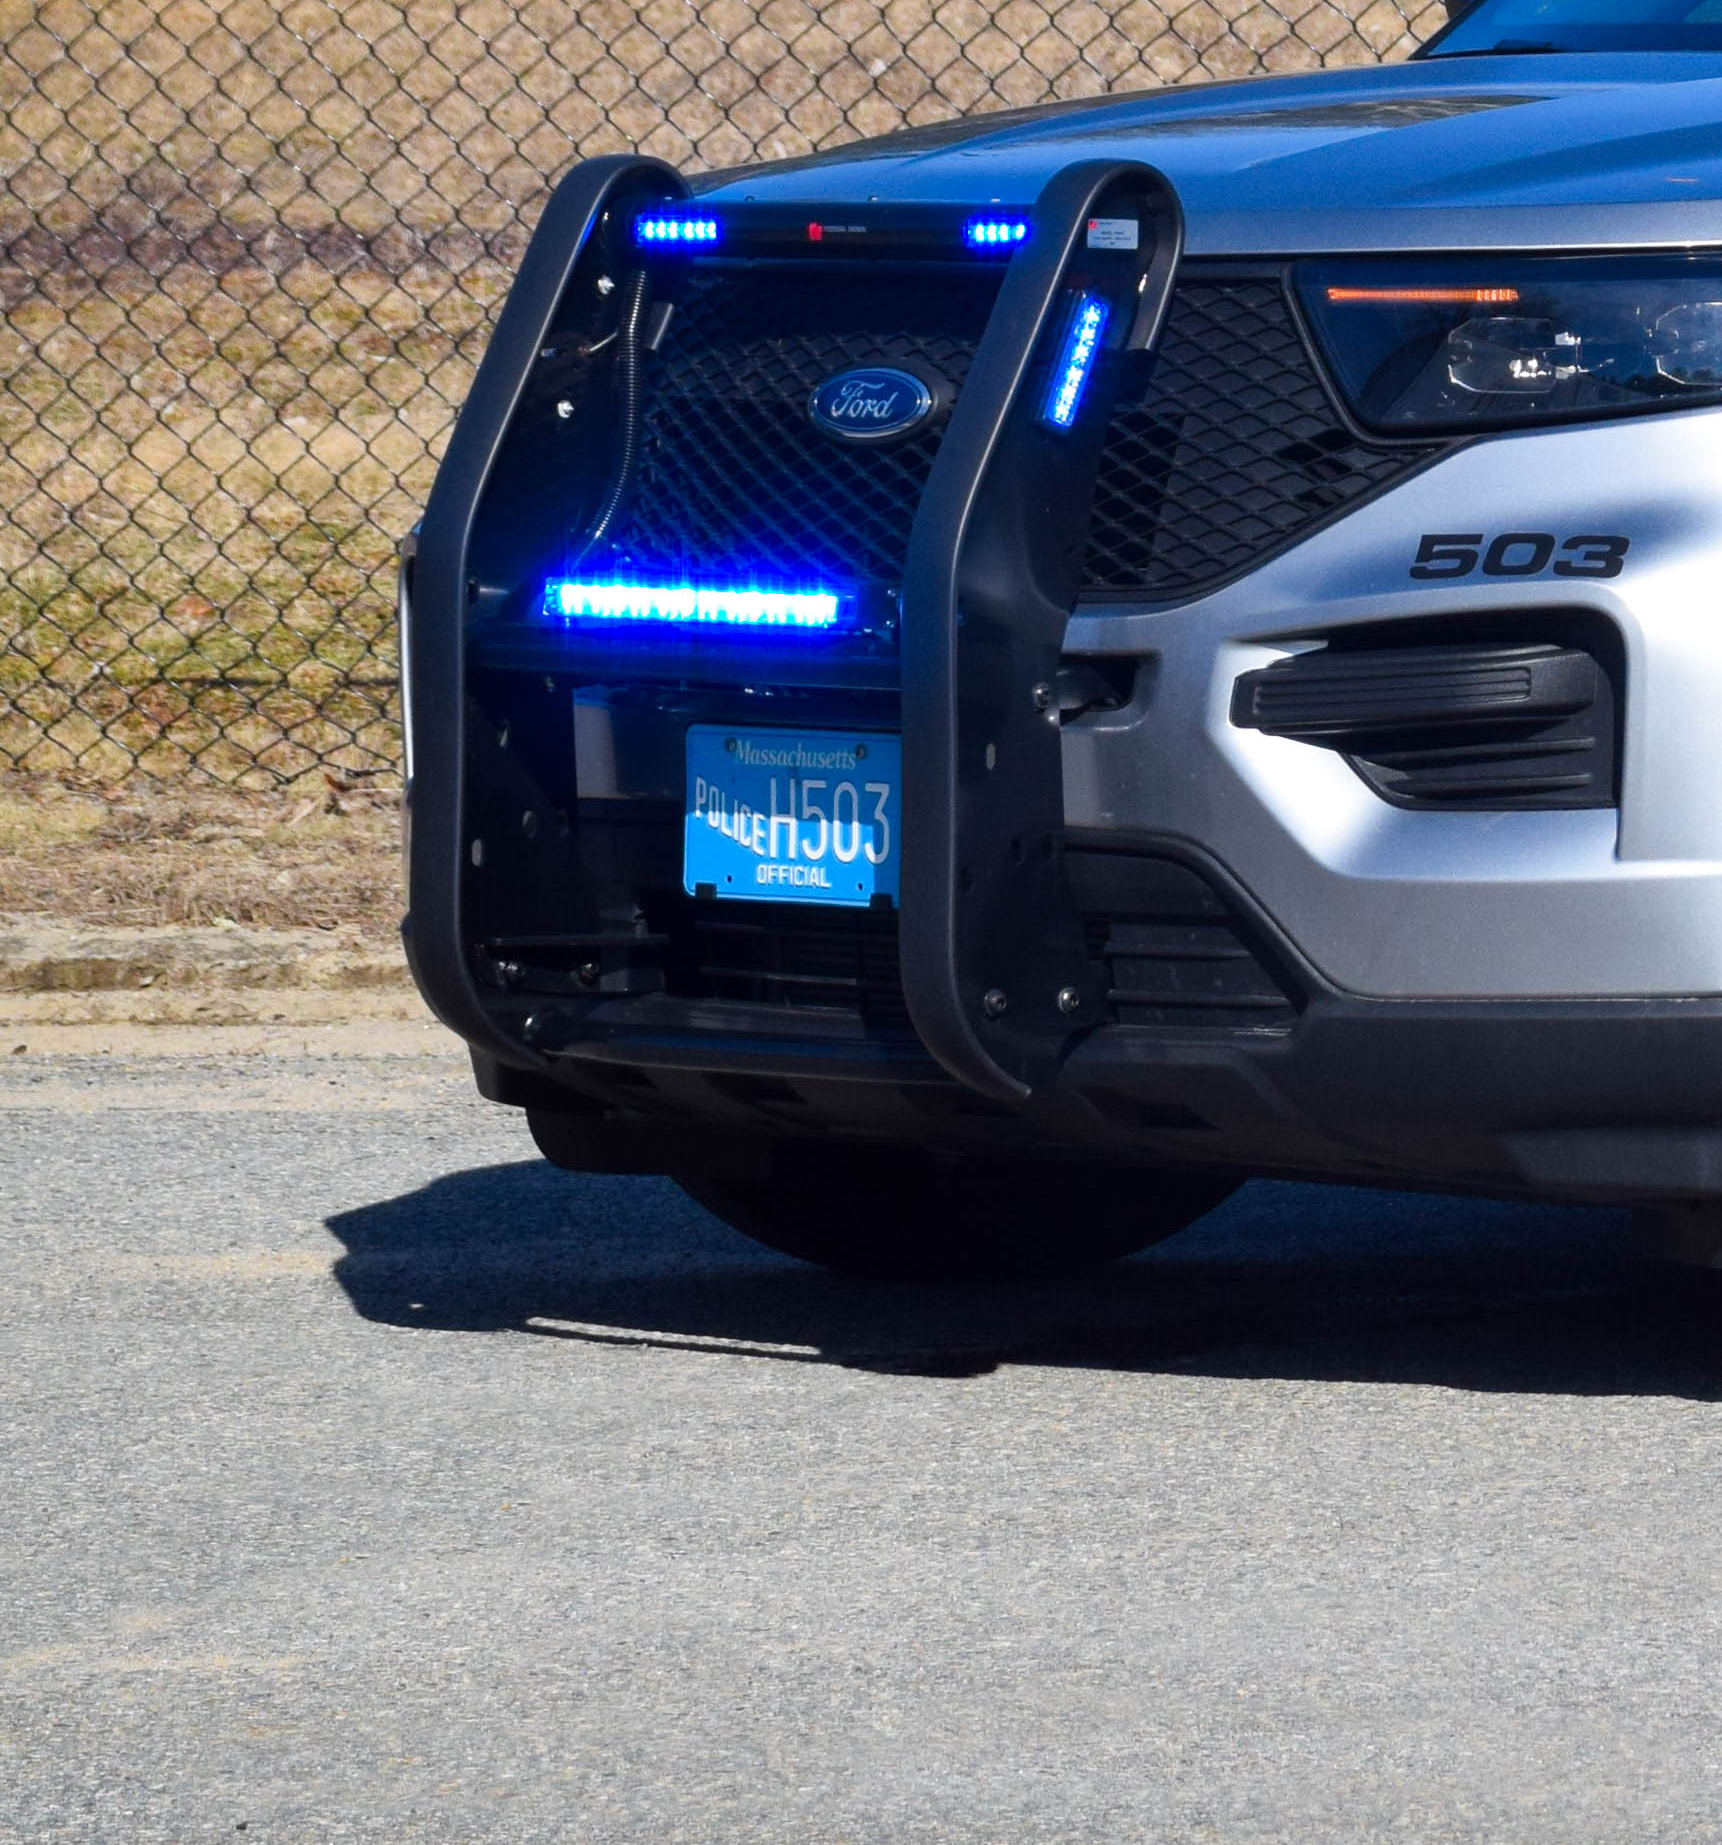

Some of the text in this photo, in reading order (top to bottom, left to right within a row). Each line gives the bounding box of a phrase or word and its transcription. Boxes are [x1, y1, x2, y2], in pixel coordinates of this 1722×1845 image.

[831, 380, 899, 418] Ford
[1409, 532, 1630, 580] 503
[733, 740, 857, 770] Massachusetts
[695, 776, 890, 864] POLICE H503
[757, 864, 832, 888] OFFICIAL
